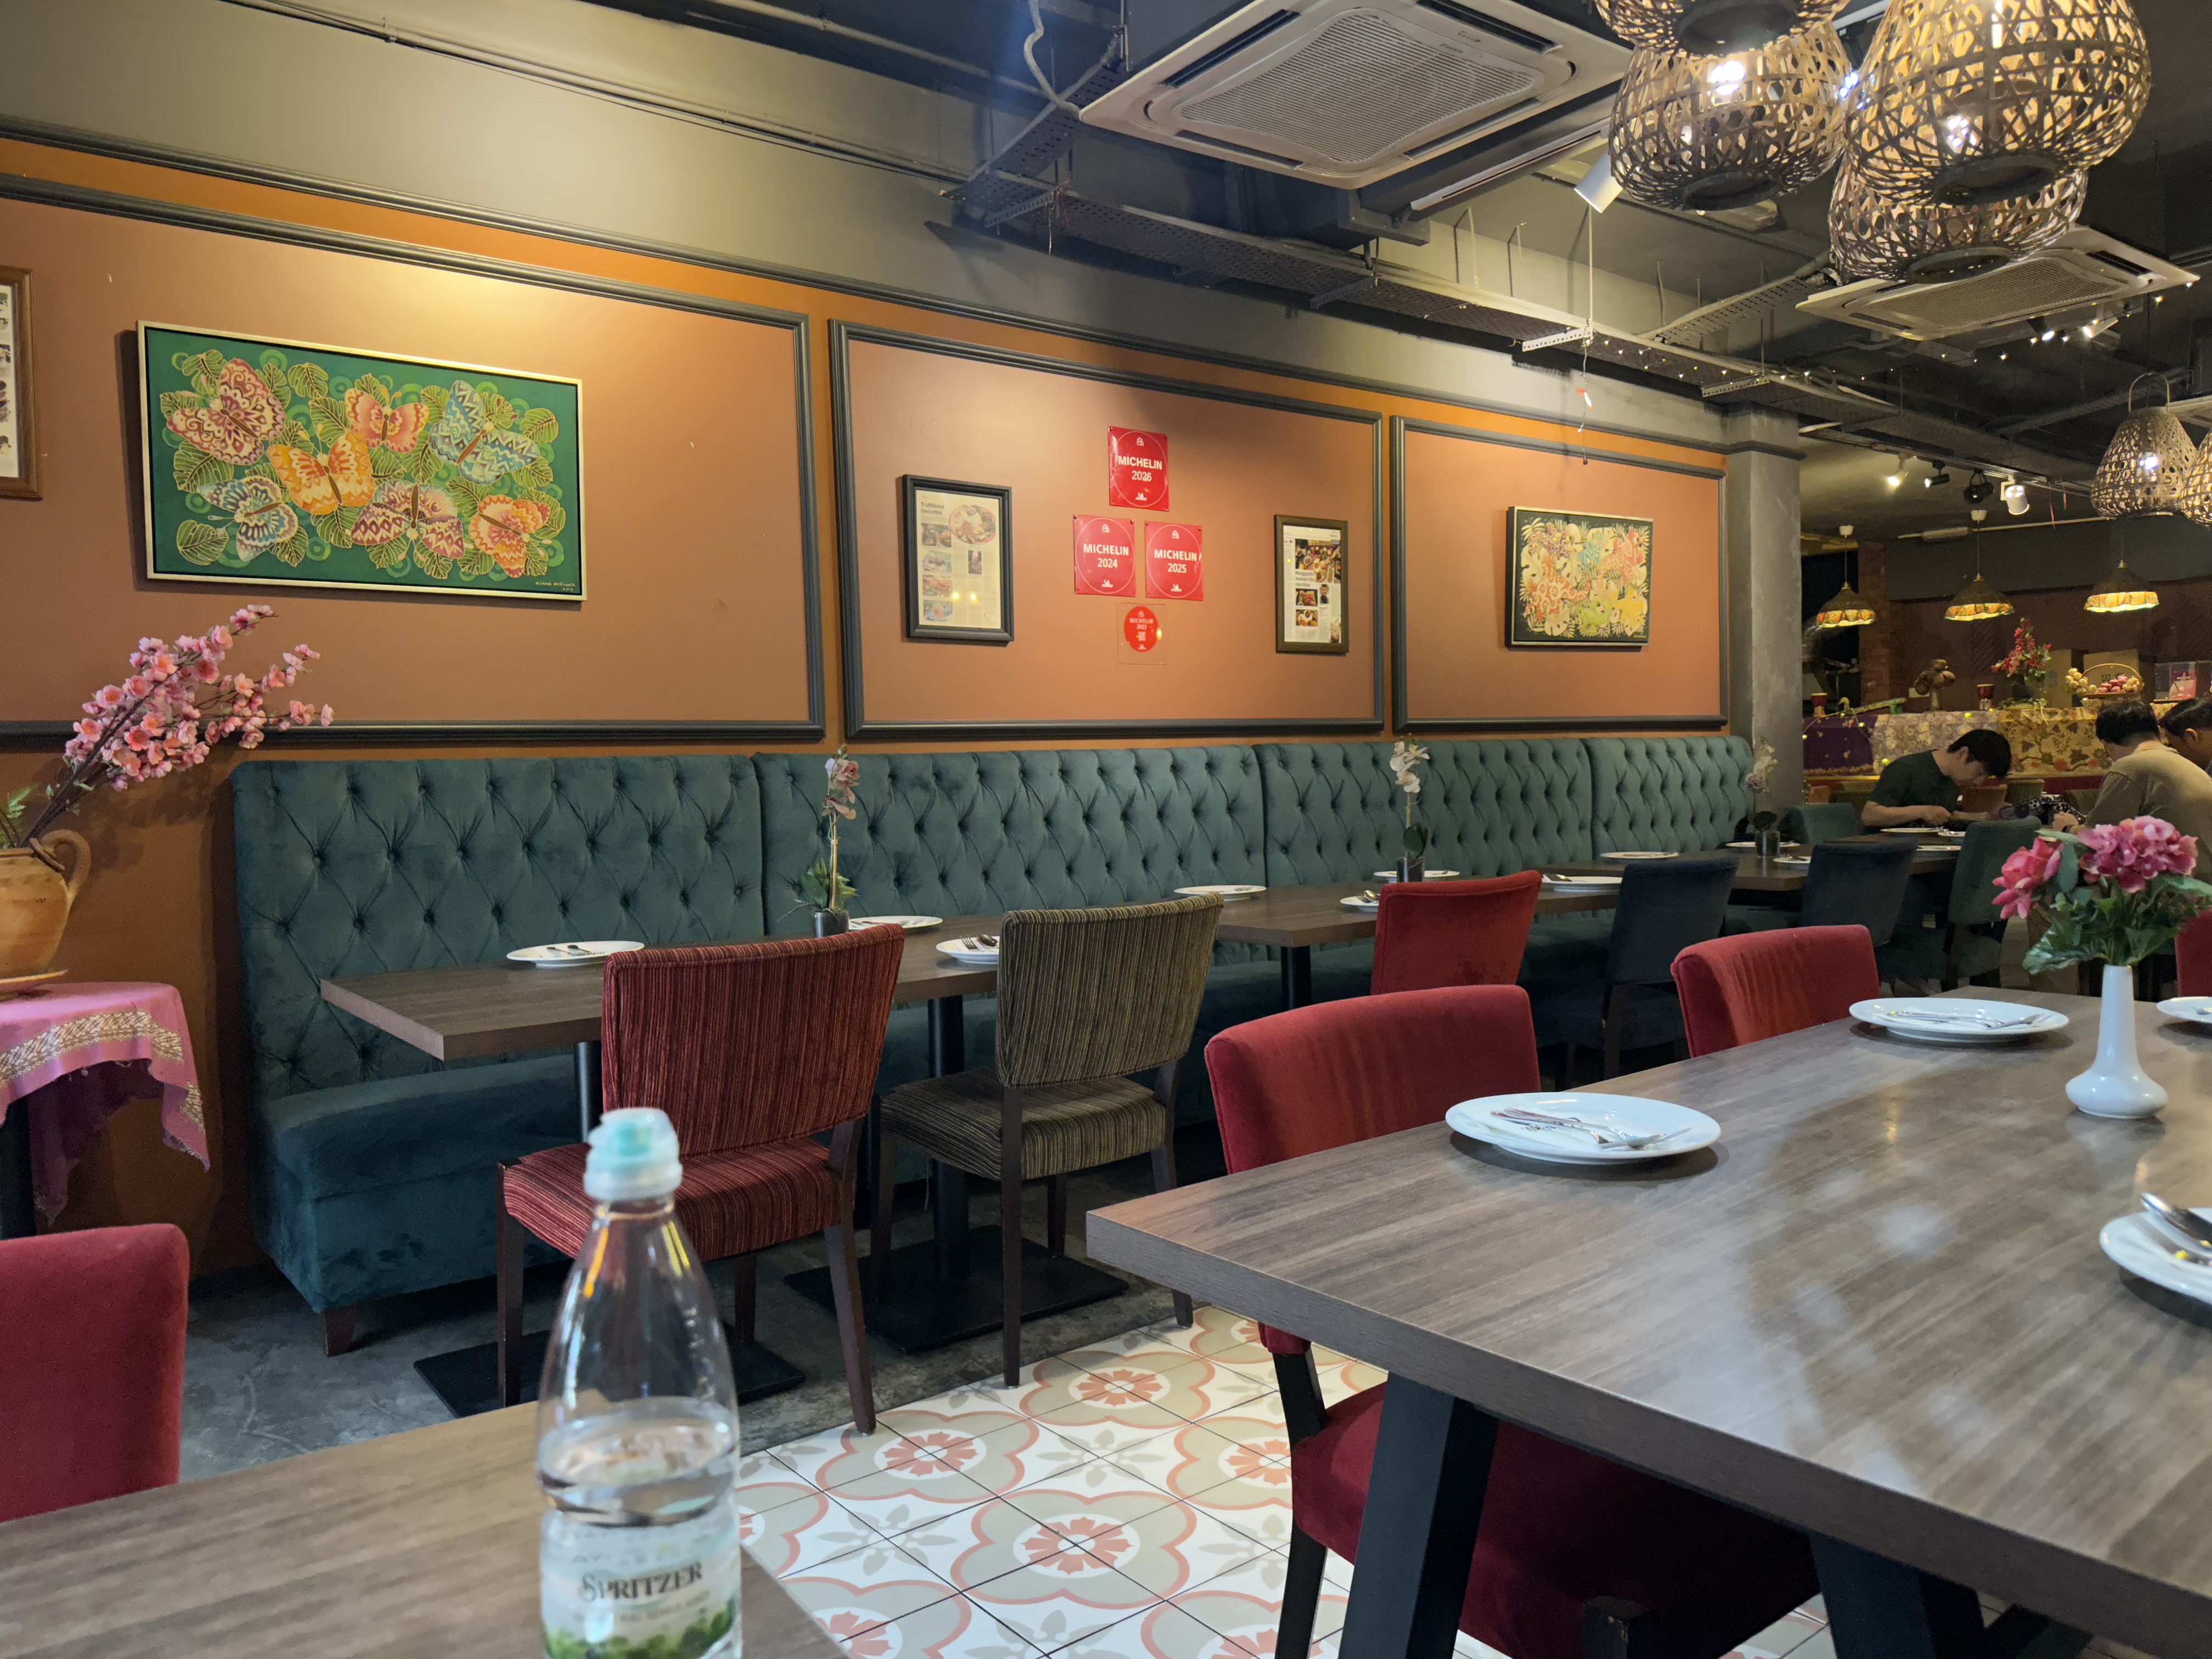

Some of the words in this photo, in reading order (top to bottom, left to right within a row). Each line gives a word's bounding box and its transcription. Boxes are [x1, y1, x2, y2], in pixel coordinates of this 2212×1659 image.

[1119, 455, 1162, 470] MICHELIN
[1132, 471, 1152, 482] 2026
[1083, 544, 1129, 556] MICHELIN
[1154, 549, 1197, 562] MICHELIN
[1097, 558, 1118, 568] 2024
[1167, 563, 1187, 574] 2025
